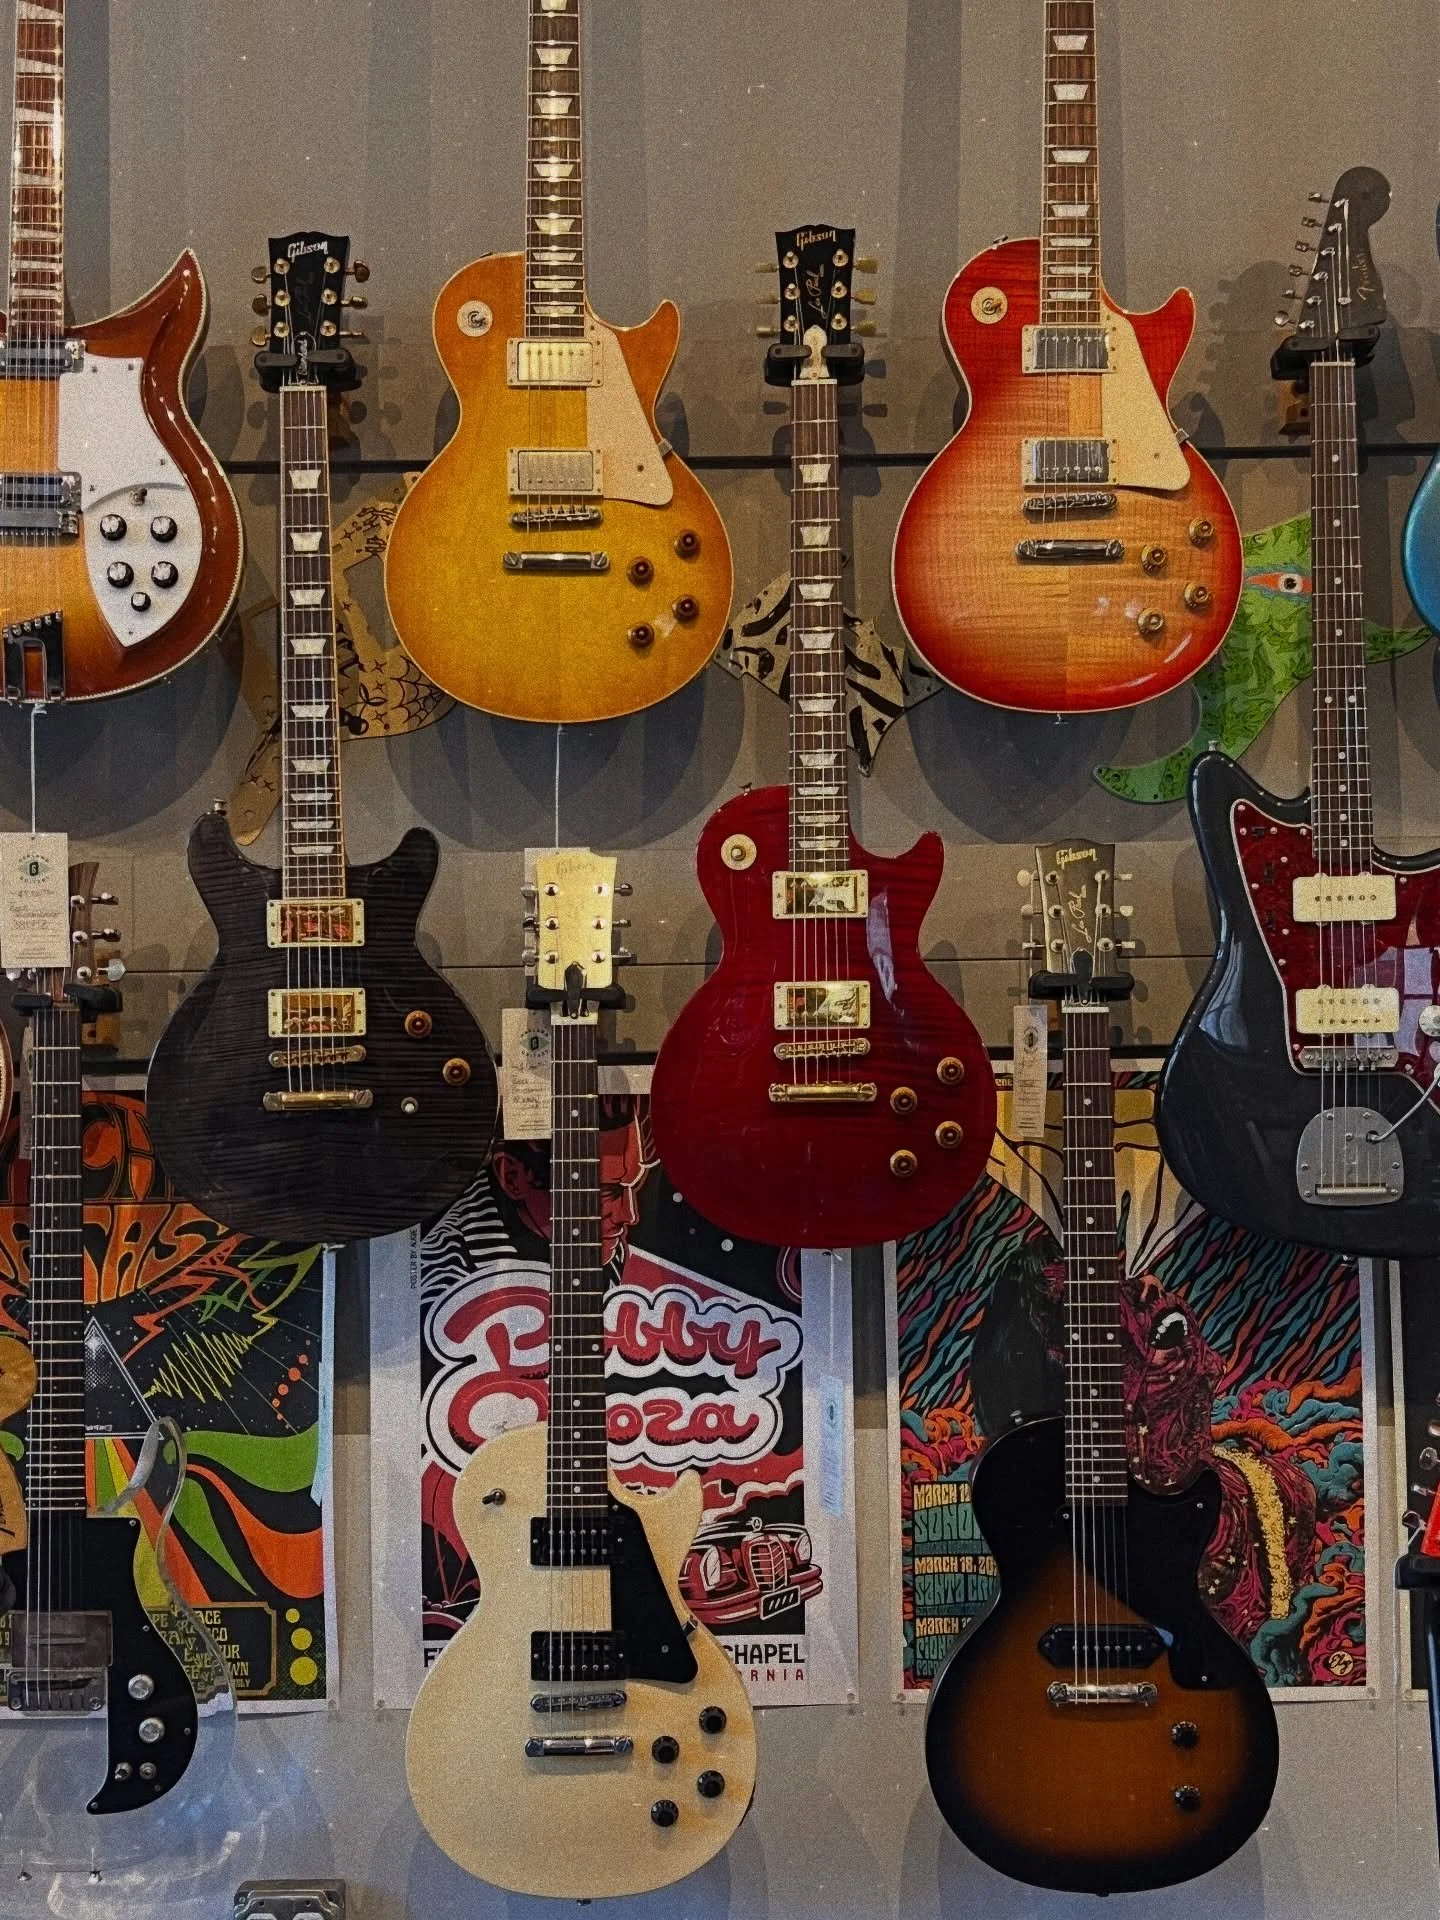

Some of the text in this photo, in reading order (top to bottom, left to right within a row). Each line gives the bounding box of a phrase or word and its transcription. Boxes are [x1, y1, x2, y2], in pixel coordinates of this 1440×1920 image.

[796, 230, 836, 251] Gibson
[287, 241, 328, 263] Gibson
[1056, 848, 1097, 870] Gibson
[443, 1286, 781, 1378] Bbby
[448, 1371, 759, 1451] Ooza
